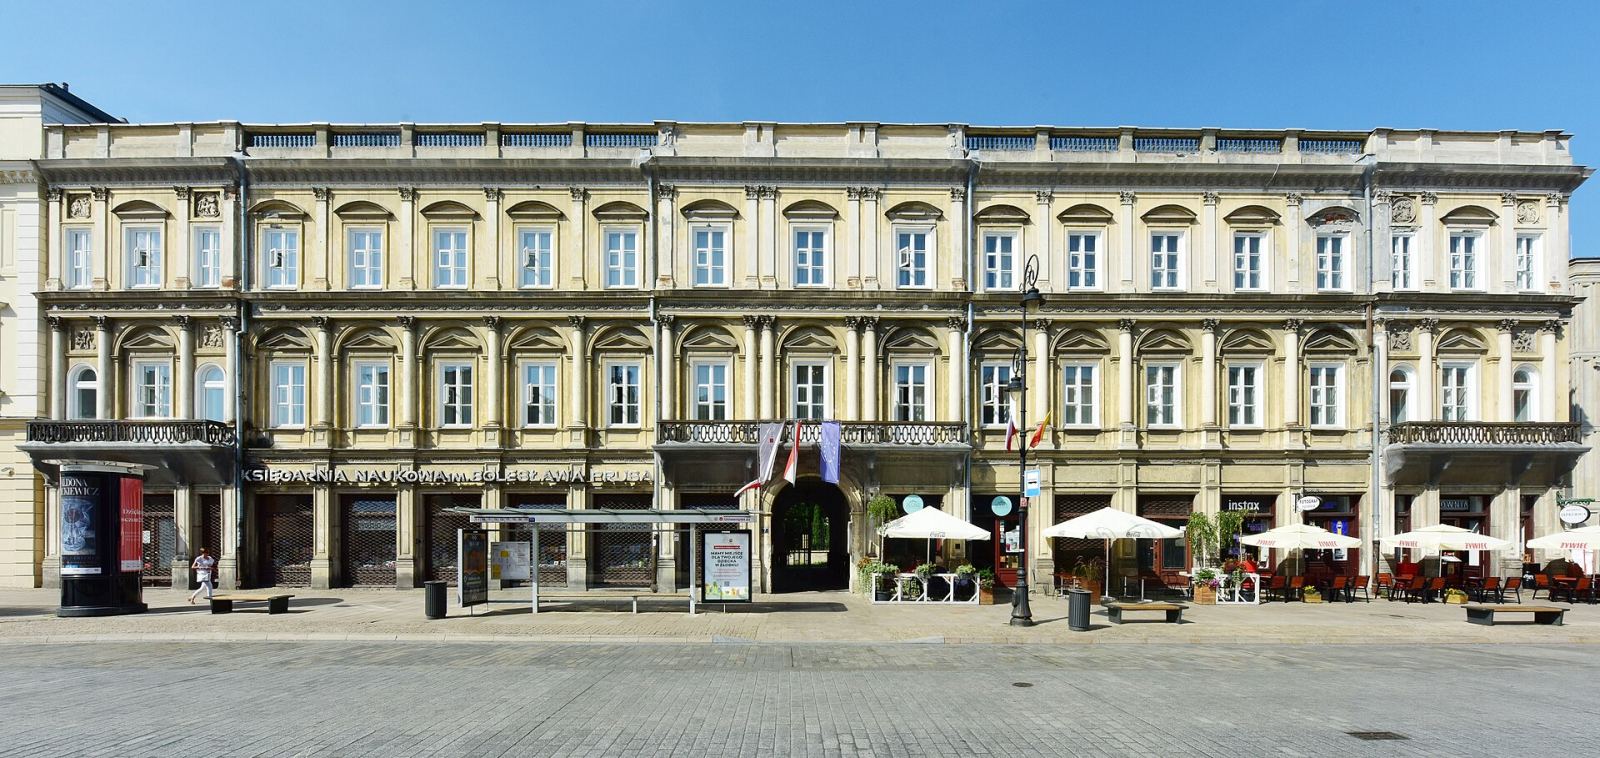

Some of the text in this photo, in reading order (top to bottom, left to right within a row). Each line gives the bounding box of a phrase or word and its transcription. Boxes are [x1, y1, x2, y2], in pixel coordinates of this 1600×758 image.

[240, 469, 347, 484] KSIĘGARNIA
[354, 469, 447, 483] NAUKOWA
[472, 470, 585, 482] BOLESŁAWA
[589, 470, 653, 482] PRUSA
[1228, 500, 1260, 511] instax
